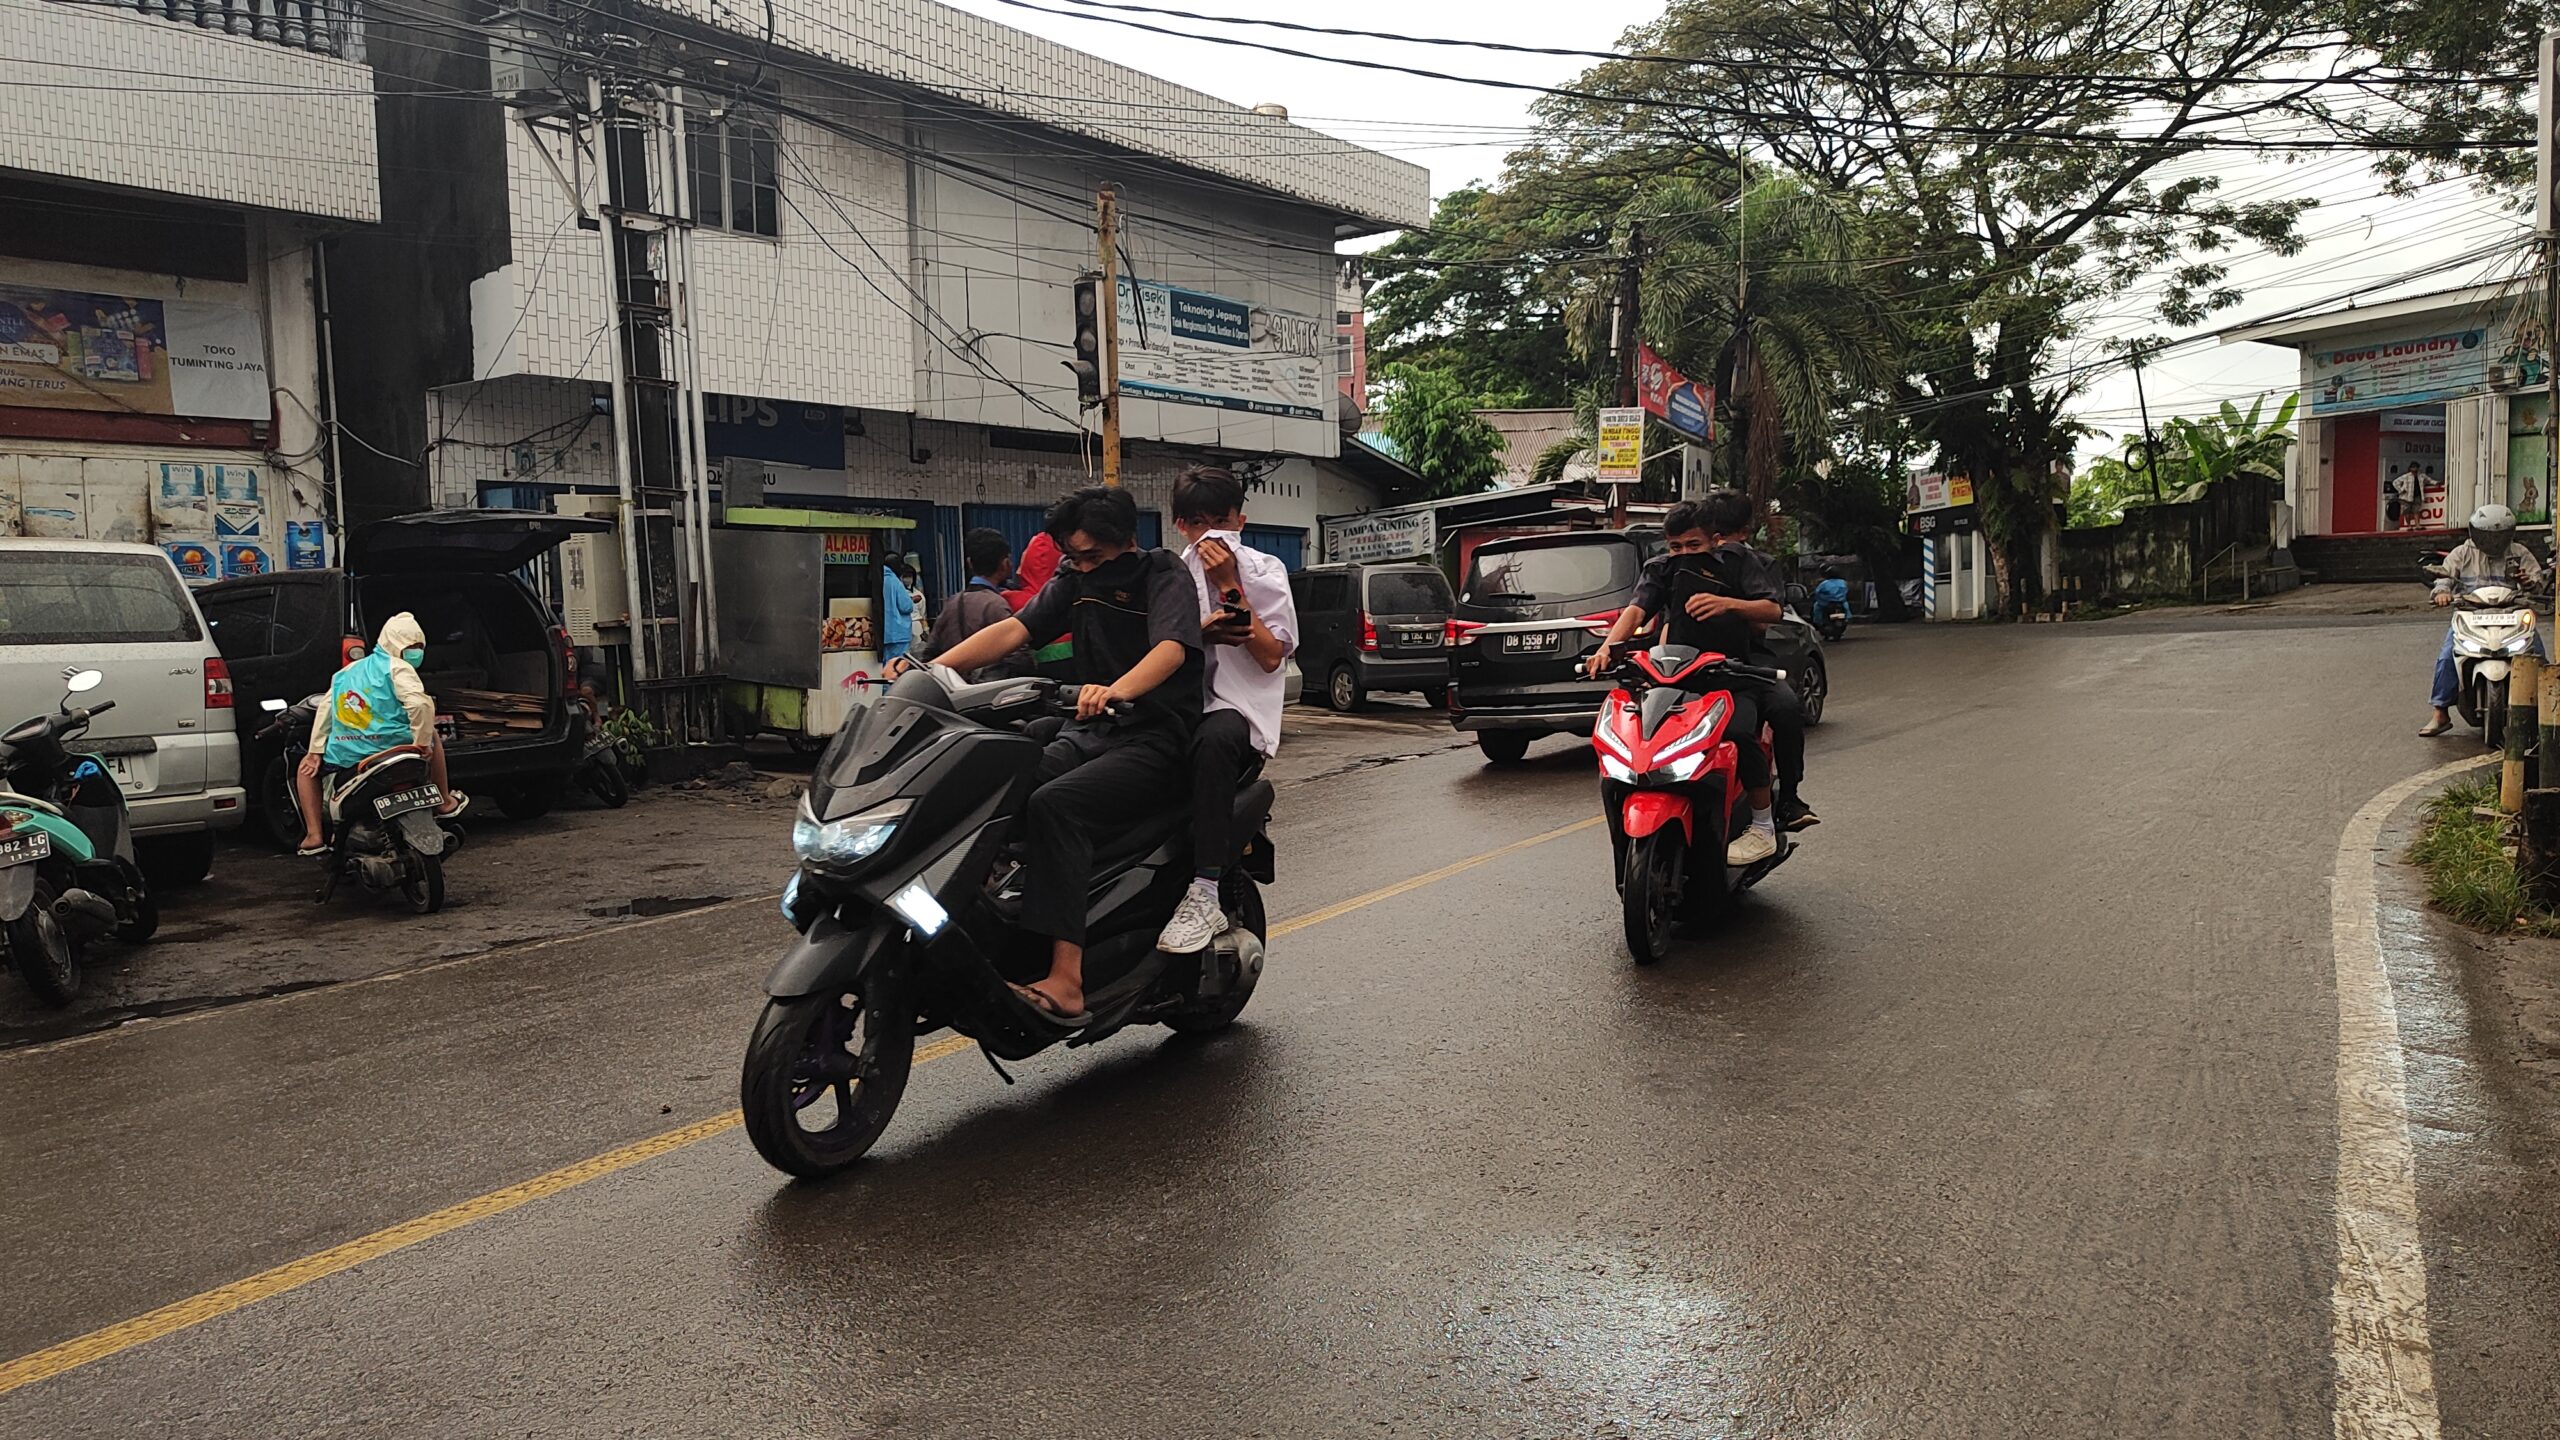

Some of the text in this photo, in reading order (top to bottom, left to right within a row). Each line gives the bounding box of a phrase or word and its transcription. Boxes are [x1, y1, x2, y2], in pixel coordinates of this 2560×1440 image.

[1137, 287, 1166, 305] iseki
[1178, 301, 1242, 326] Teknologi Jepang
[1272, 315, 1320, 358] GRATIS
[12, 346, 46, 359] EMAS
[203, 344, 236, 356] TOKO
[2333, 335, 2459, 365] Dava Laundry
[169, 356, 265, 373] TUMINTING JAYA
[30, 378, 66, 391] TERUS
[2404, 441, 2431, 454] Dava
[1342, 518, 1419, 538] TAMPA GUNTING
[1920, 515, 1936, 530] BSG
[840, 553, 869, 563] NART
[1506, 632, 1558, 647] DB 1558 FP
[377, 797, 392, 810] DB
[394, 790, 420, 804] 3817
